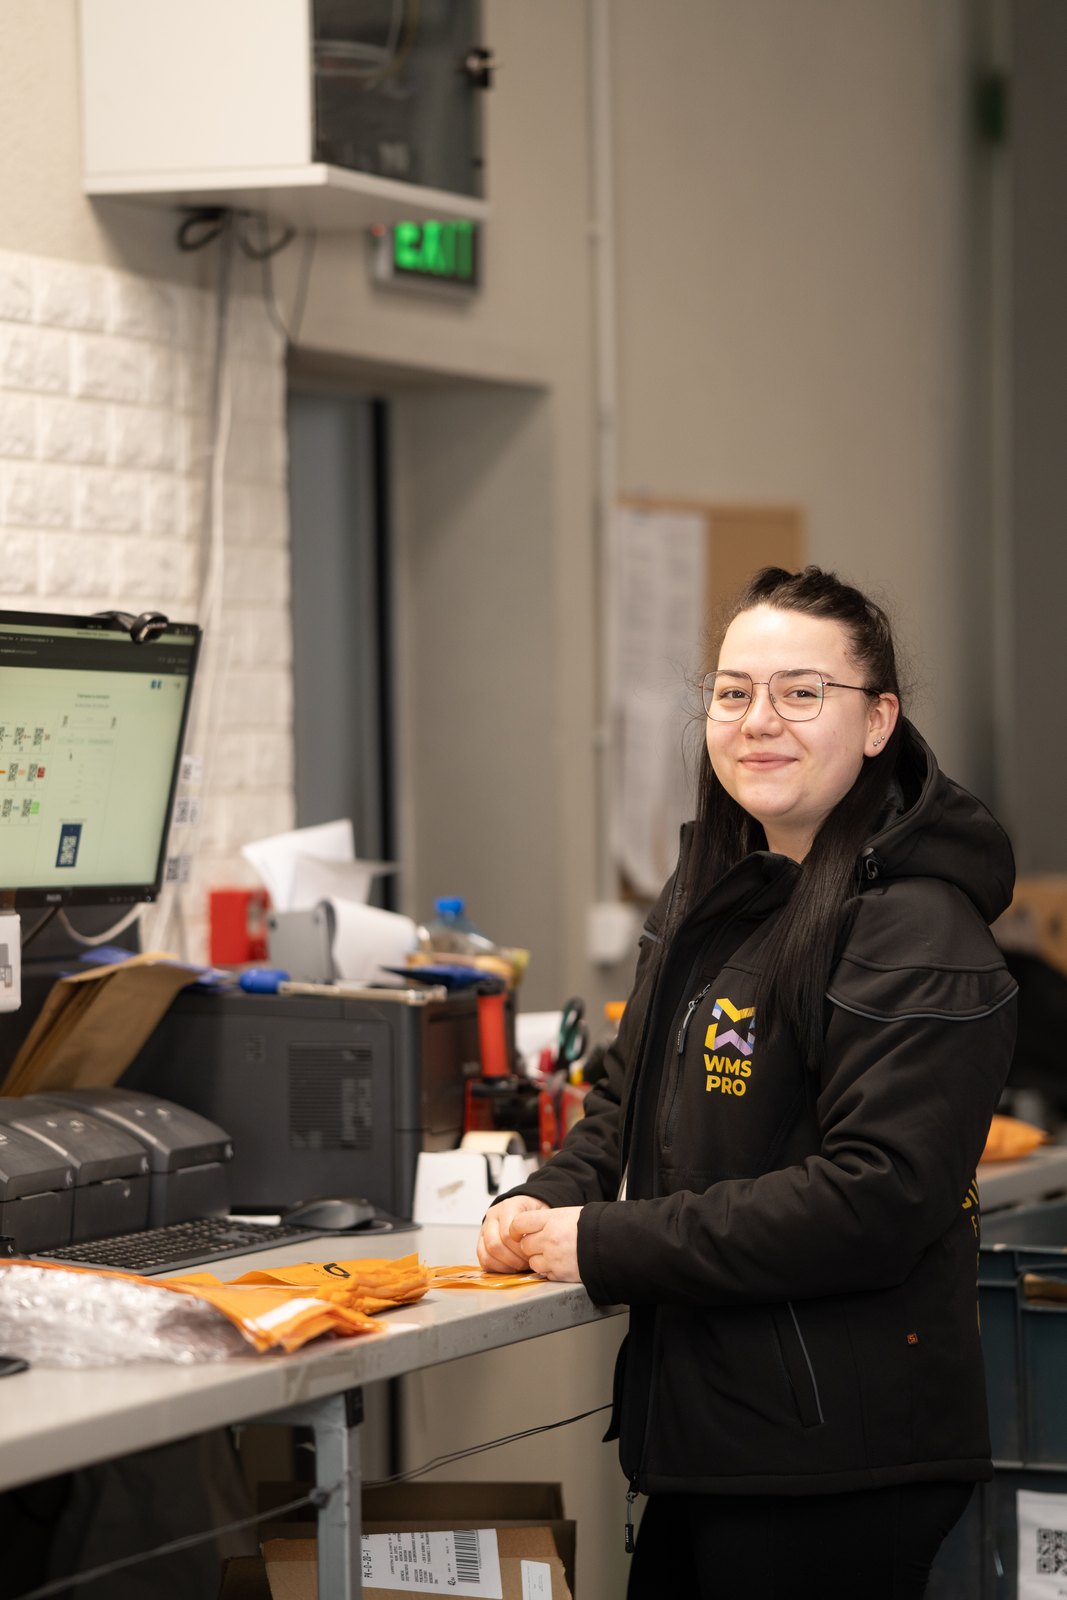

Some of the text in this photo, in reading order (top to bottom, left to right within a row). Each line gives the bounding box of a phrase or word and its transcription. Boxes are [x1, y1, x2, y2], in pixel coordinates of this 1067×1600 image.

[394, 219, 474, 279] EXIT
[704, 1054, 752, 1077] WMS
[706, 1075, 746, 1096] PRO
